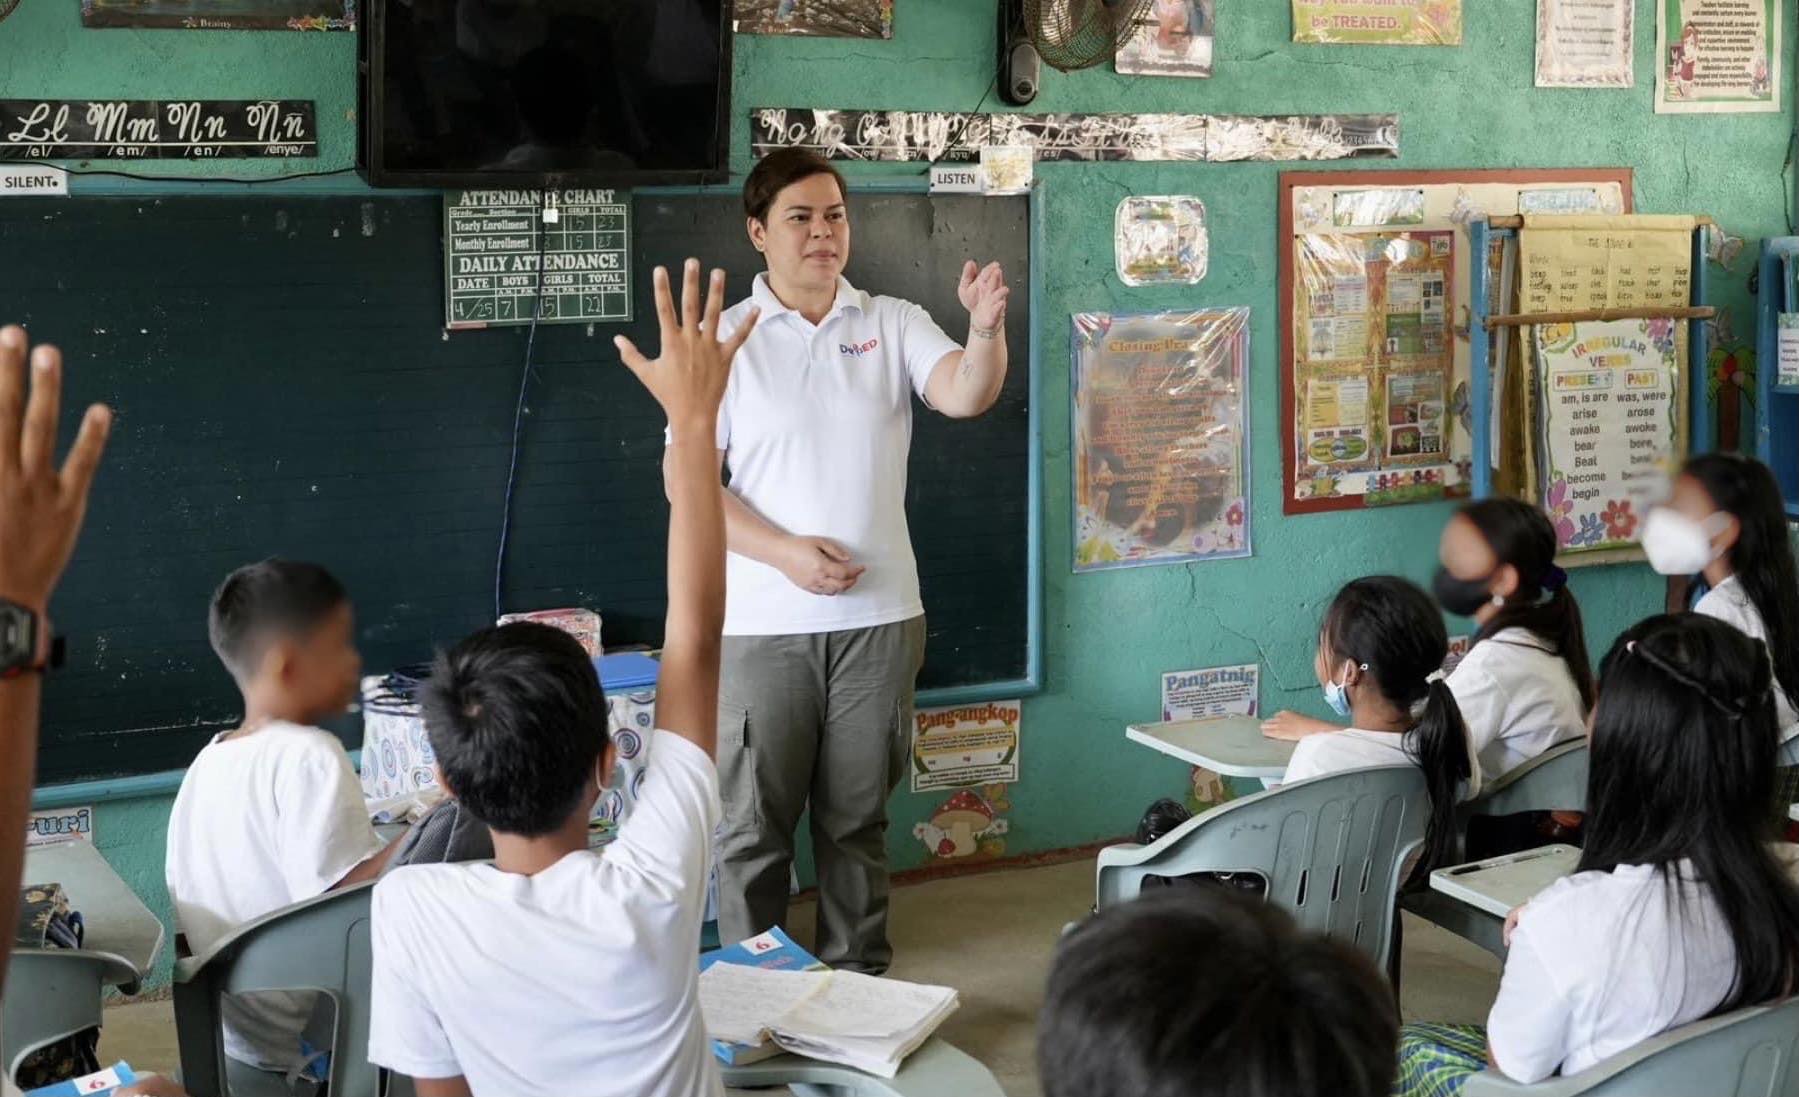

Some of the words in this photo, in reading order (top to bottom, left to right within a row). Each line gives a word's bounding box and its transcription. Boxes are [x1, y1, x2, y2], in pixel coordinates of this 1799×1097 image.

[201, 18, 231, 28] Brainy
[86, 102, 158, 143] Mm
[168, 102, 228, 142] Nn
[937, 173, 976, 185] LISTEN
[460, 190, 561, 206] ATTENDANE
[564, 189, 616, 204] CHART
[455, 220, 481, 232] Yearly
[483, 219, 529, 230] Enrollment
[455, 238, 486, 252] Monthly
[487, 236, 529, 249] Enrollment
[459, 256, 508, 273] DAILY
[511, 253, 619, 272] ATTENDANCE
[458, 278, 490, 289] DATE
[502, 276, 529, 286] BOYS
[544, 275, 574, 285] GIRLS
[587, 273, 621, 283] TOTAL
[501, 300, 512, 316] 7
[1627, 372, 1655, 385] PAST
[1561, 395, 1580, 405] am,
[1581, 391, 1590, 402] is
[1592, 392, 1609, 403] are
[1617, 394, 1640, 403] was,
[1642, 391, 1667, 401] were
[1572, 408, 1598, 420] arise
[1627, 408, 1655, 418] arose
[1569, 424, 1601, 436] awake
[1625, 421, 1657, 433] awoke
[1574, 440, 1597, 452] bear
[1575, 456, 1598, 468] Beat
[1567, 472, 1606, 485] become
[1572, 487, 1600, 501] begin
[1166, 667, 1256, 692] Pangatnig
[755, 941, 771, 950] 6
